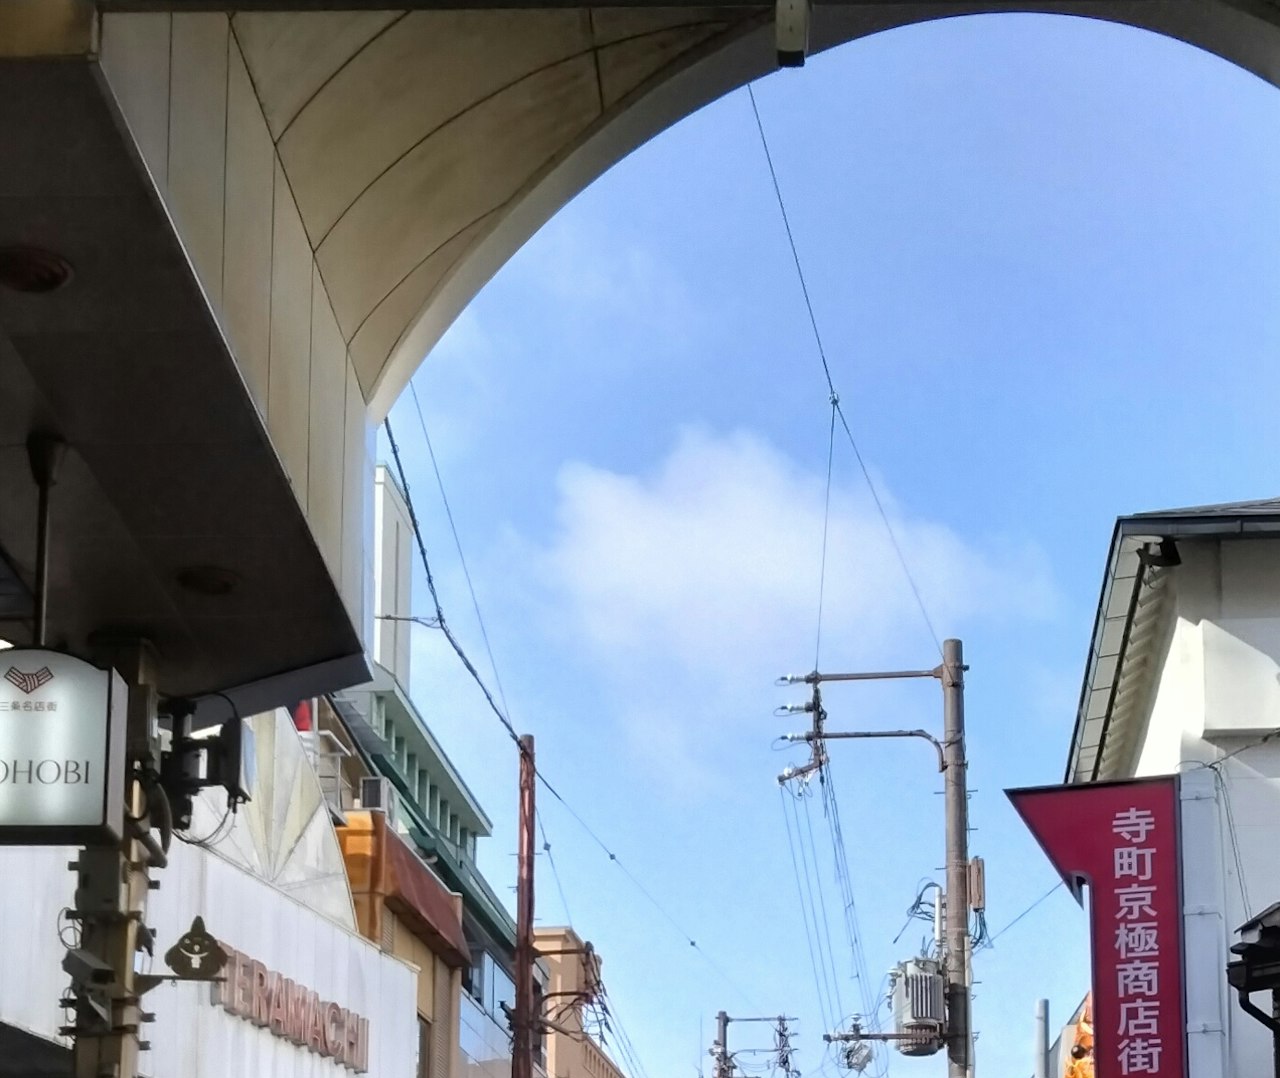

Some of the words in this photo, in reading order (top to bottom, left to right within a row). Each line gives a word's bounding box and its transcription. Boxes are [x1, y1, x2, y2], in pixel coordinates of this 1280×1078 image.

[1111, 806, 1163, 1076] 寺町京極商店街
